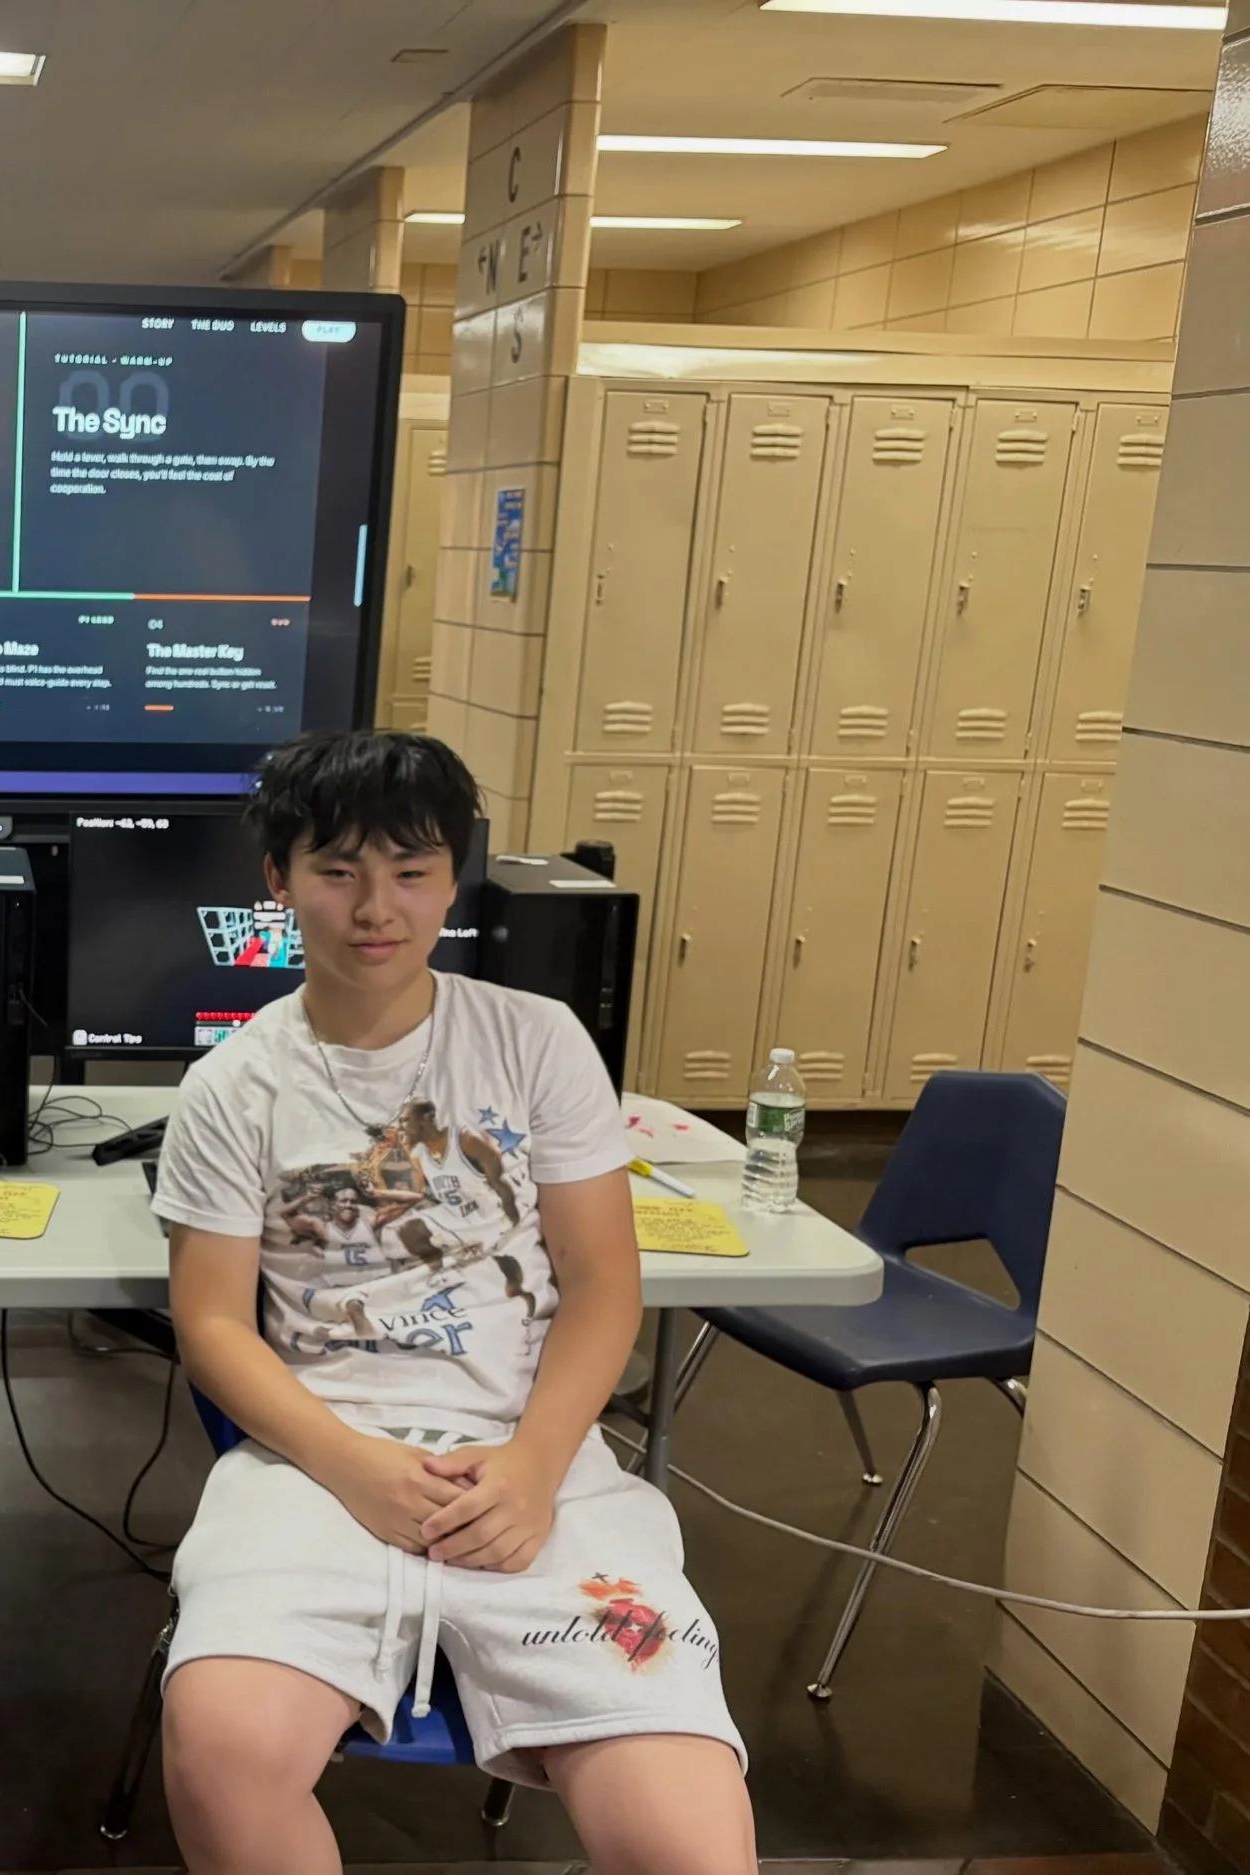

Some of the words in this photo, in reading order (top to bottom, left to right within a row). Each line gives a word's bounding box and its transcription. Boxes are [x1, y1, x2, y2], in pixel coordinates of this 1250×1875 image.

[508, 147, 521, 203] C
[518, 225, 531, 283] E
[142, 317, 174, 329] STORY
[191, 319, 211, 330] THE
[250, 321, 287, 333] LEVELS
[54, 353, 108, 365] TUTORIAL
[120, 355, 173, 367] WARM-UP
[52, 405, 101, 433] The
[102, 407, 167, 440] Sync
[3, 640, 40, 657] Maze
[146, 642, 172, 659] The
[172, 643, 217, 659] Master
[217, 644, 245, 662] Key
[88, 1033, 121, 1045] Control
